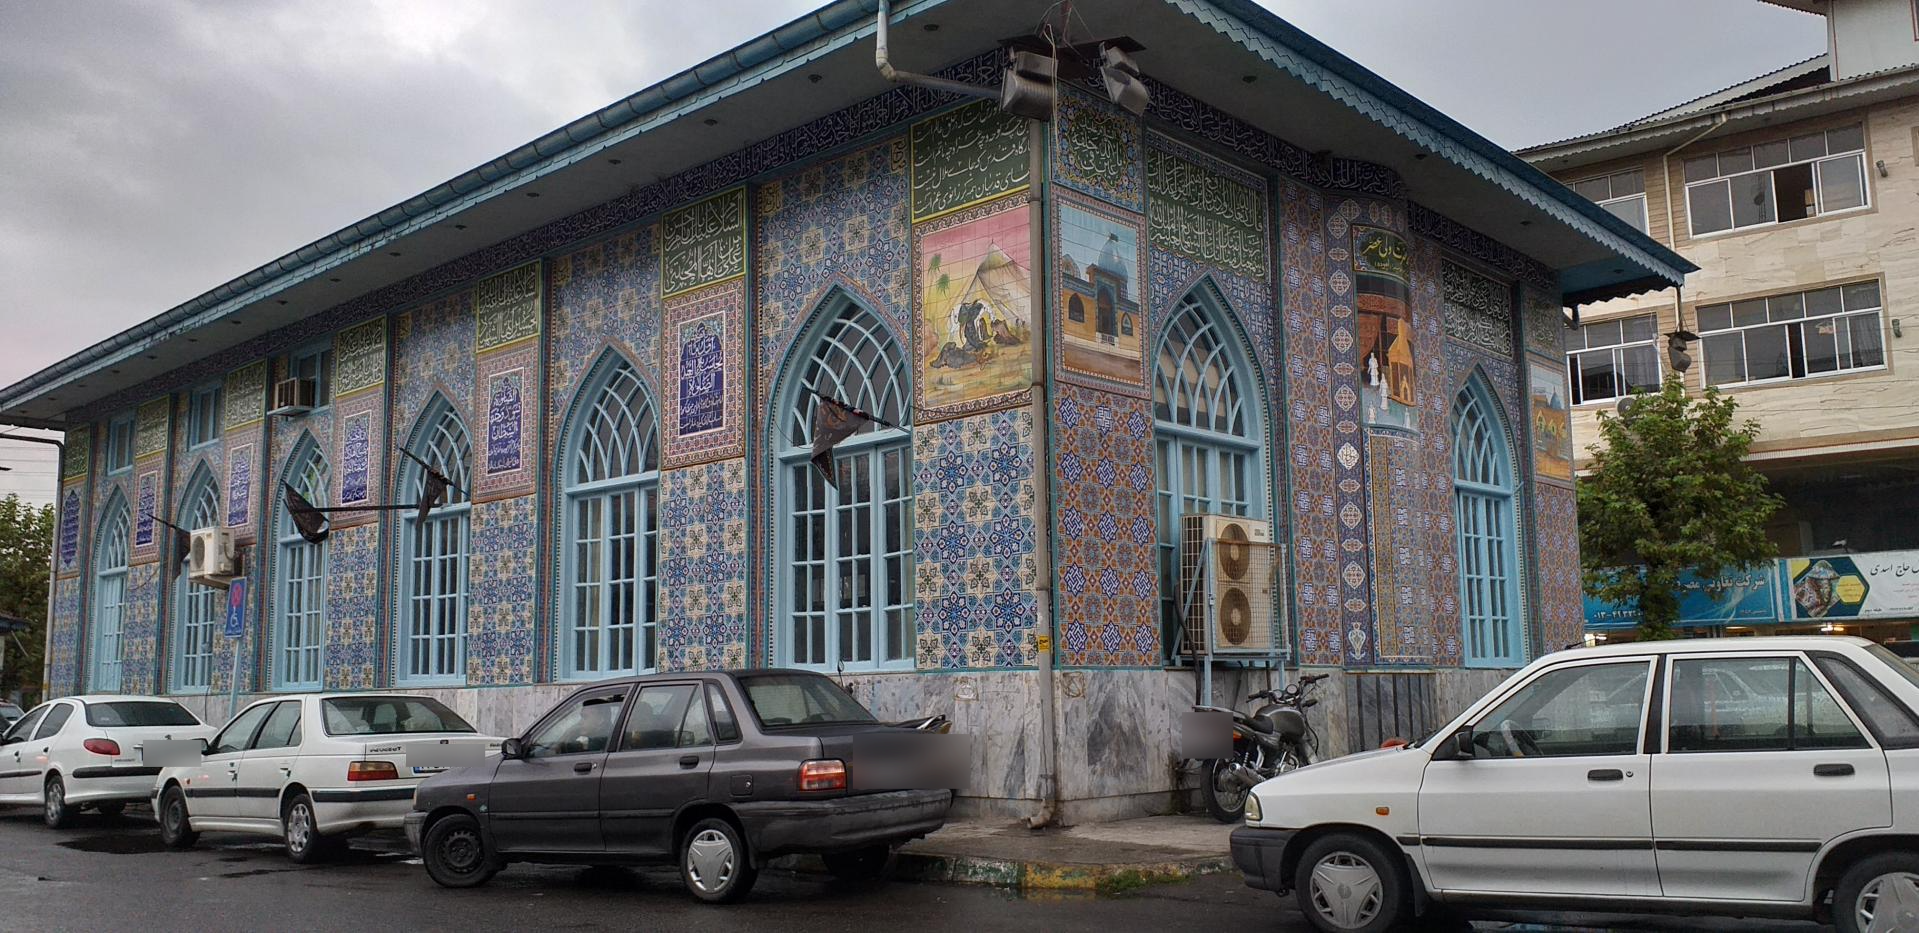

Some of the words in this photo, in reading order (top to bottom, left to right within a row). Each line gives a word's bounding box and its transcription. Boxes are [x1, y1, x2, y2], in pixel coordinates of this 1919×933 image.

[1013, 136, 1031, 156] ارگاه
[914, 167, 937, 189] نیست
[914, 192, 932, 213] است
[1870, 563, 1893, 576] اسدی
[1896, 562, 1909, 577] حاج
[1735, 576, 1766, 590] شرکت
